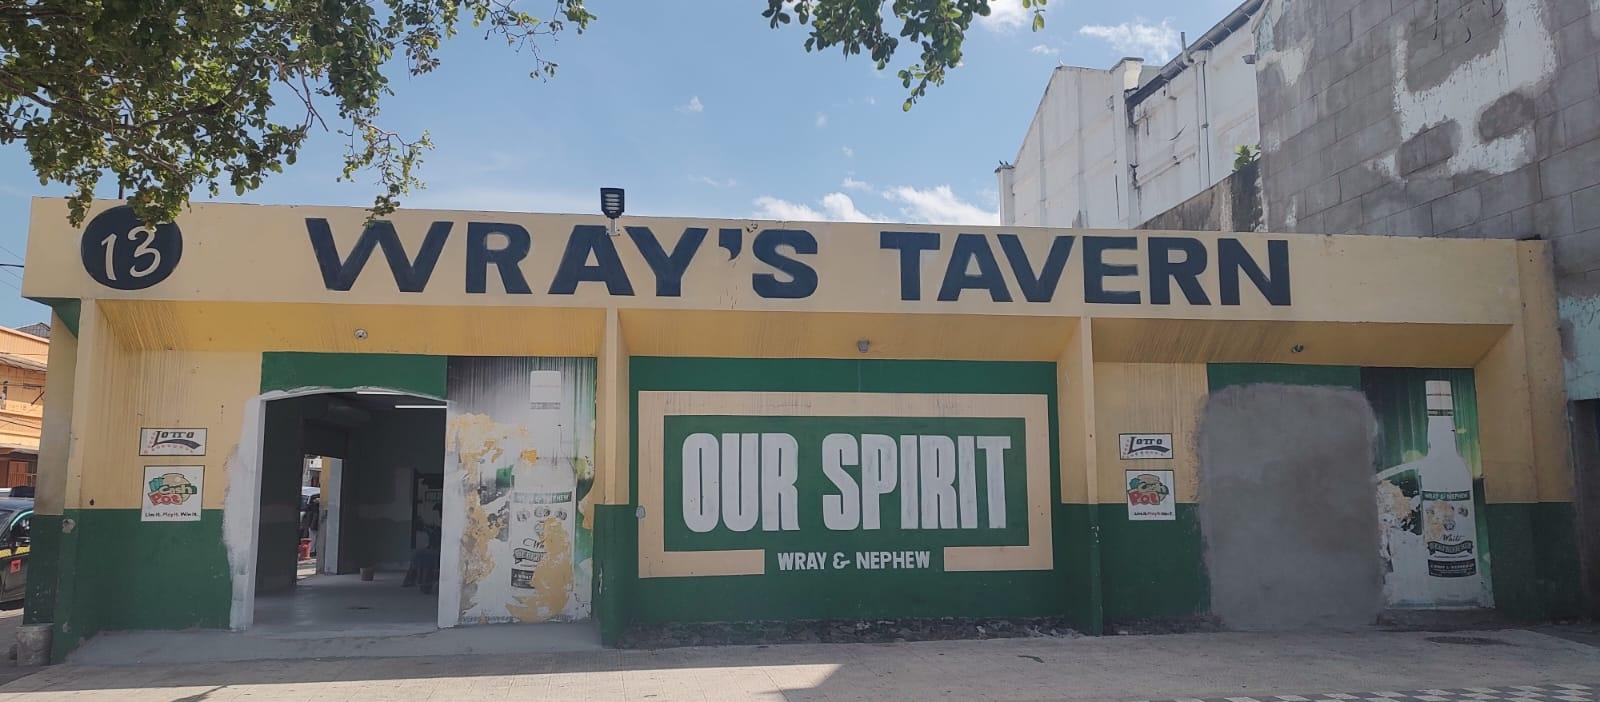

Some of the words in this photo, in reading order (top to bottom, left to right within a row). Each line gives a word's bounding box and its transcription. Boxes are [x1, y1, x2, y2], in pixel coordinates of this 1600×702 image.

[101, 225, 161, 281] 13
[305, 217, 819, 299] WRAY'S
[880, 230, 1292, 307] TAVERN
[682, 432, 800, 533] OUR
[821, 433, 1012, 531] SPIRIT
[777, 551, 828, 571] WRAY
[832, 551, 851, 570] &
[855, 550, 931, 570] NEPHEW
